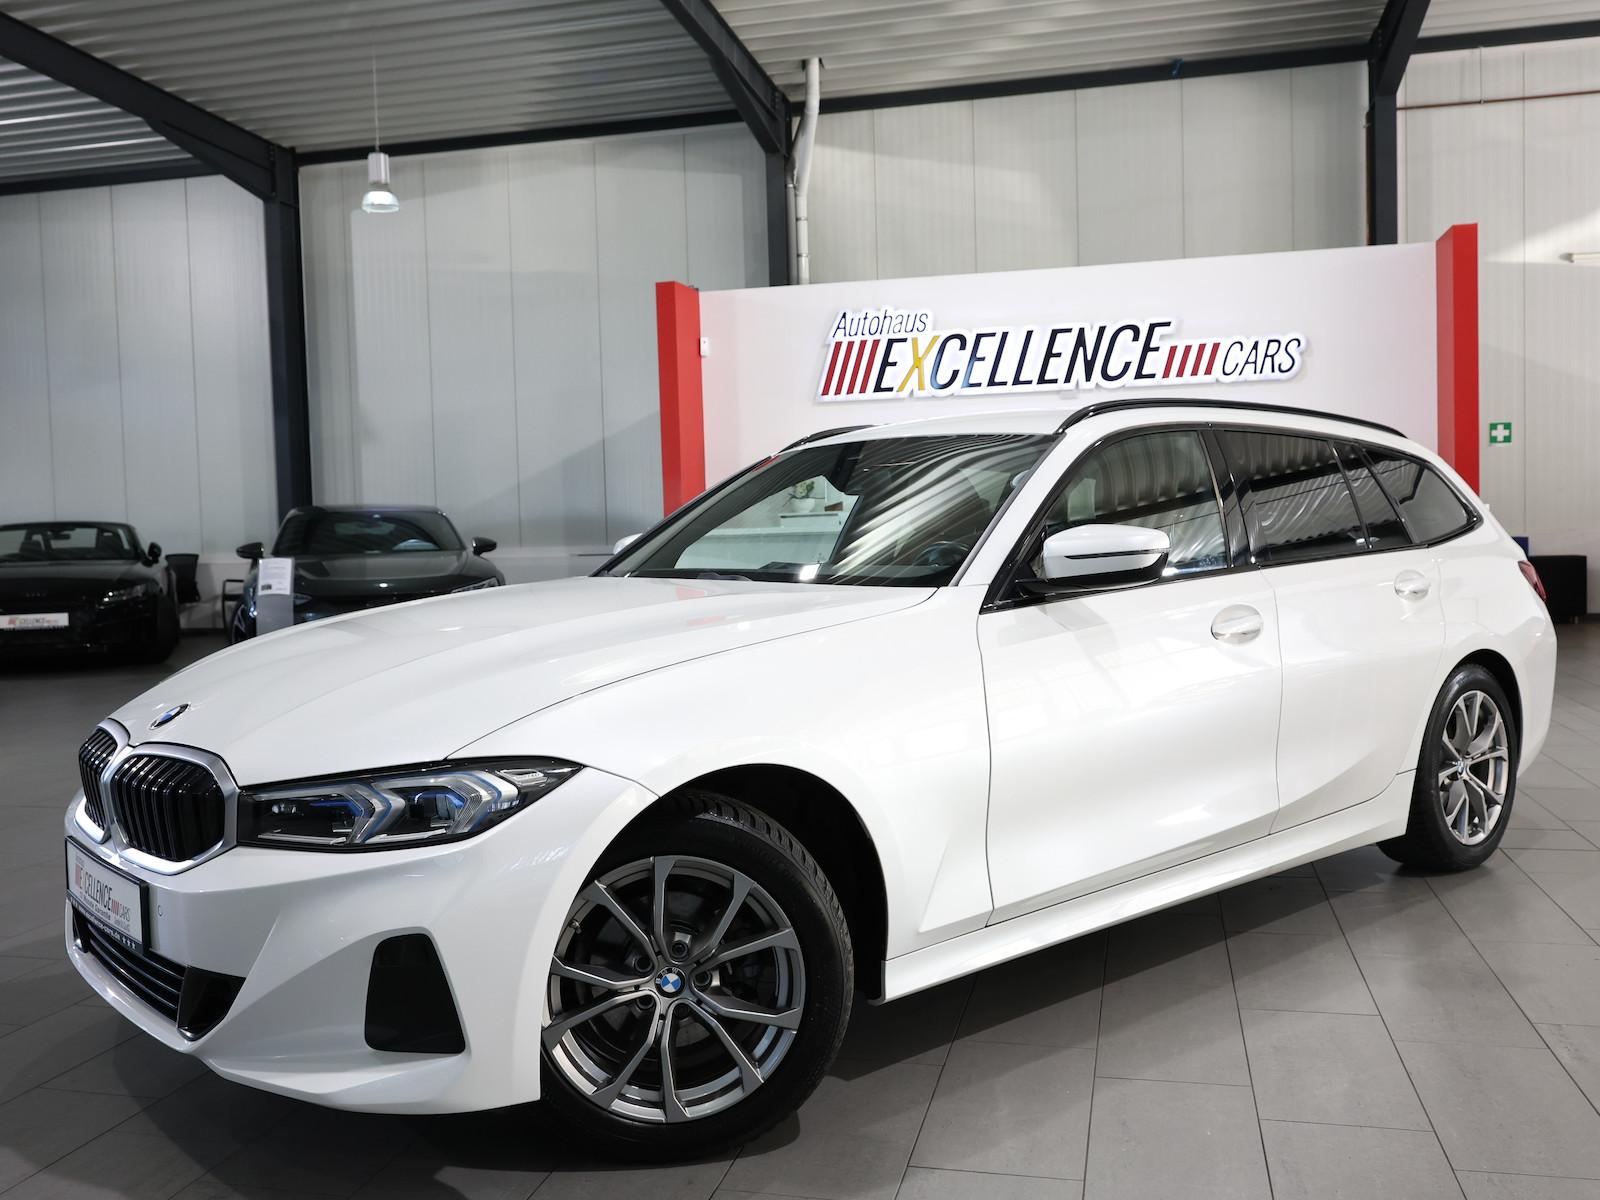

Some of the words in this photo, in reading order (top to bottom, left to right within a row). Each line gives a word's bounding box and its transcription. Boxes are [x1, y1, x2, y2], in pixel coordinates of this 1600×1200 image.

[832, 309, 929, 339] Autohaus
[872, 321, 1172, 394] EXCELLENCE
[1222, 338, 1301, 376] CARS
